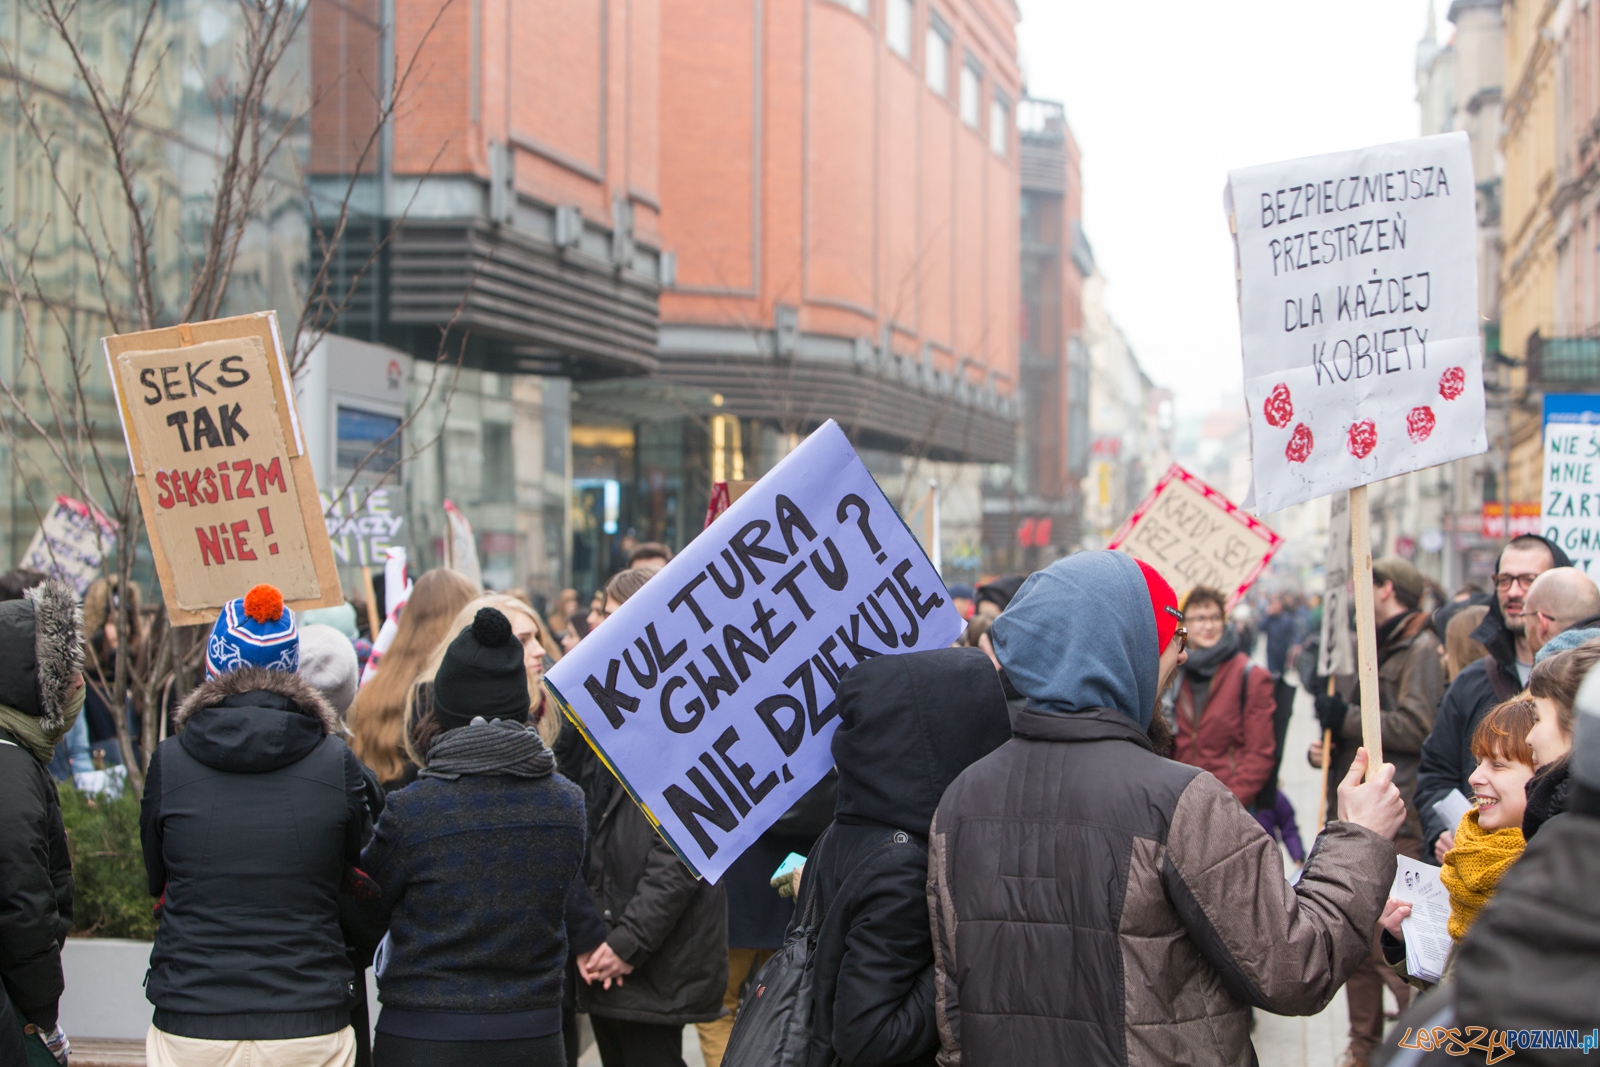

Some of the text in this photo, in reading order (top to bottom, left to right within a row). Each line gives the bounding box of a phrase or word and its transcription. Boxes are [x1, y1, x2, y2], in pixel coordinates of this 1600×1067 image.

[1261, 166, 1450, 228] BEZPIECZNIEJSZA
[1268, 211, 1407, 276] PRZESTRZEŃ
[1285, 268, 1431, 332] DLA KAŻDEJ
[139, 356, 251, 406] SEKS
[1312, 326, 1429, 387] KOBIETY
[166, 402, 250, 452] TAK
[1551, 431, 1600, 458] NIE Ś
[319, 486, 391, 518] NIE
[323, 515, 403, 537] NACZY
[330, 535, 391, 567] NIE
[1134, 517, 1181, 562] BEZ
[1214, 534, 1260, 575] SEX
[583, 493, 818, 730] KULTURA
[662, 725, 795, 860] NIE,
